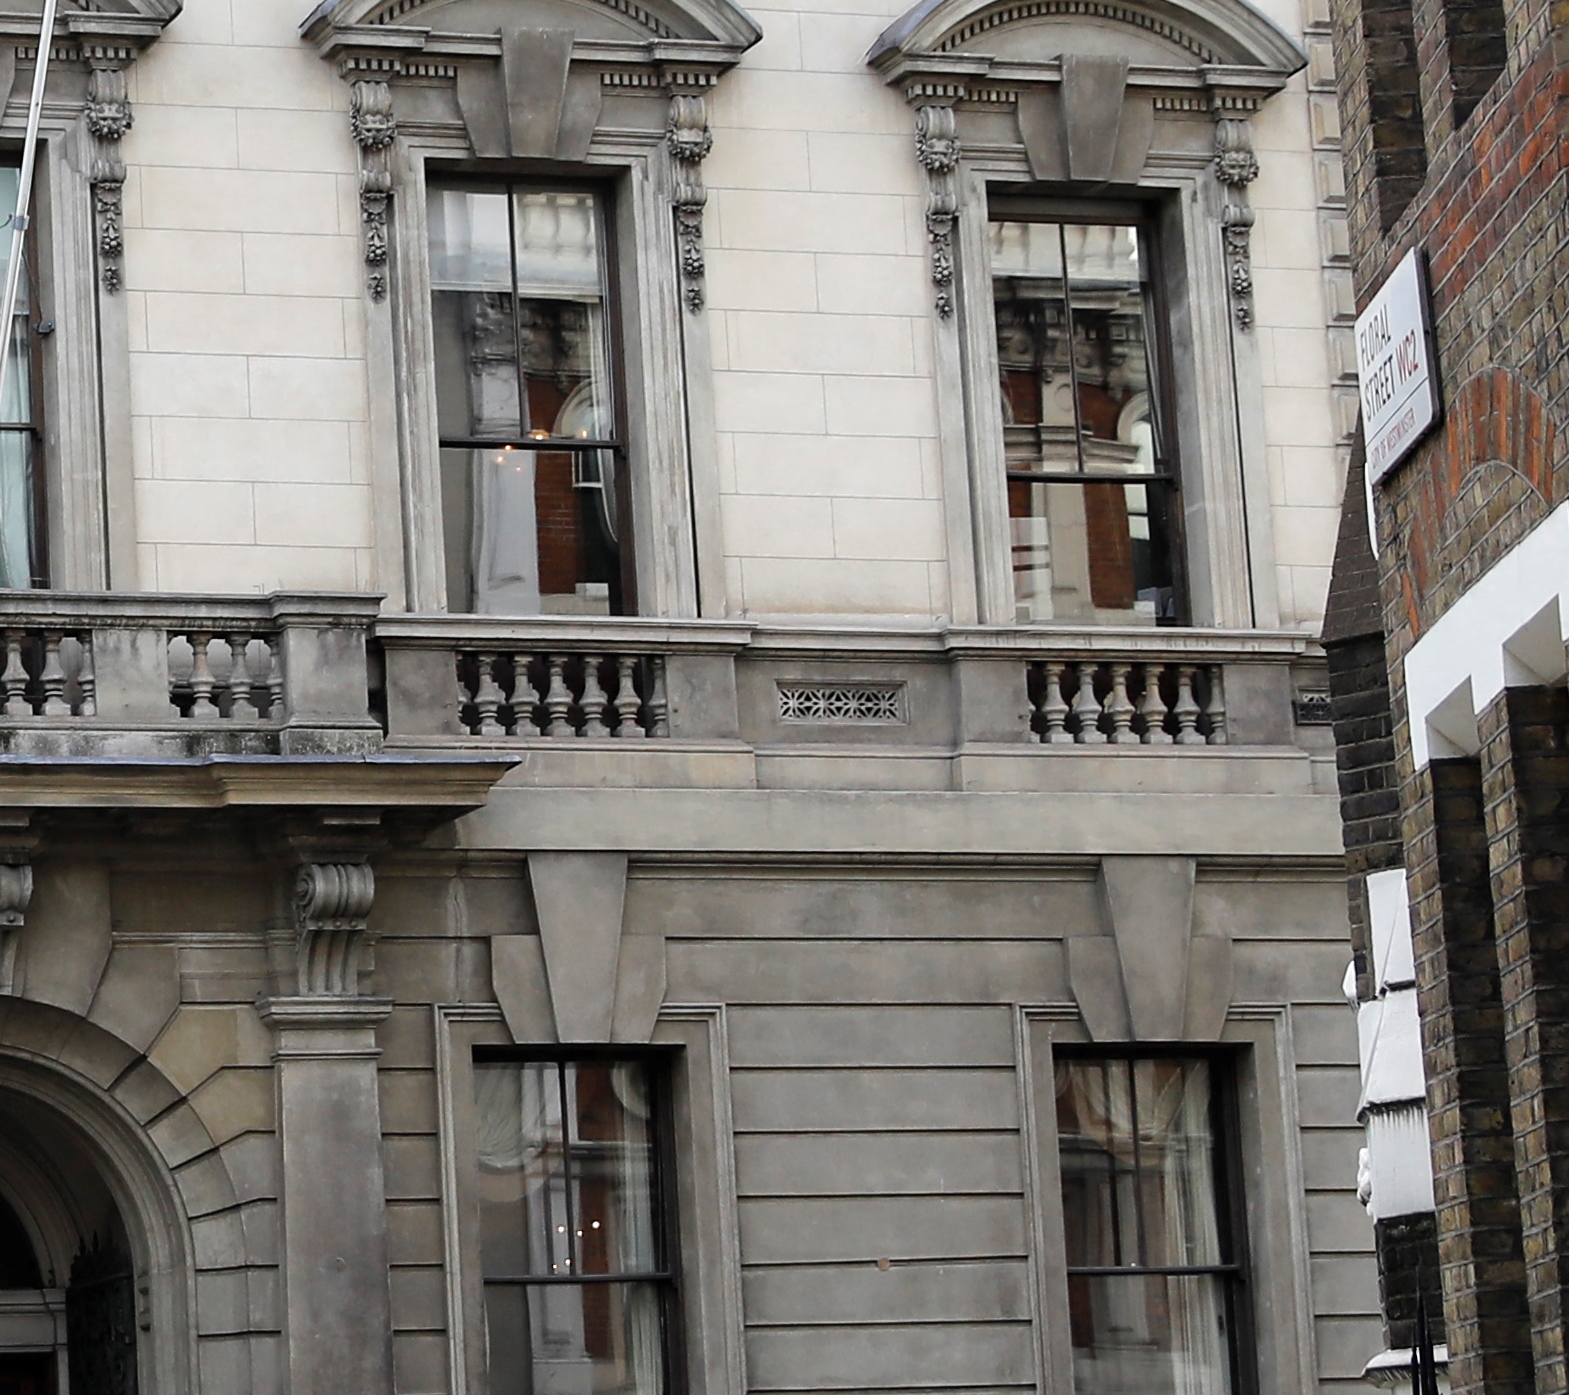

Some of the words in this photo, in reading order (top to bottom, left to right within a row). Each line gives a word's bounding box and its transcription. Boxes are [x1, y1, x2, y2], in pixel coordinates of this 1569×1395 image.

[1360, 303, 1391, 372] FLORAL
[1364, 353, 1396, 422] STREET
[1395, 328, 1419, 385] WC2
